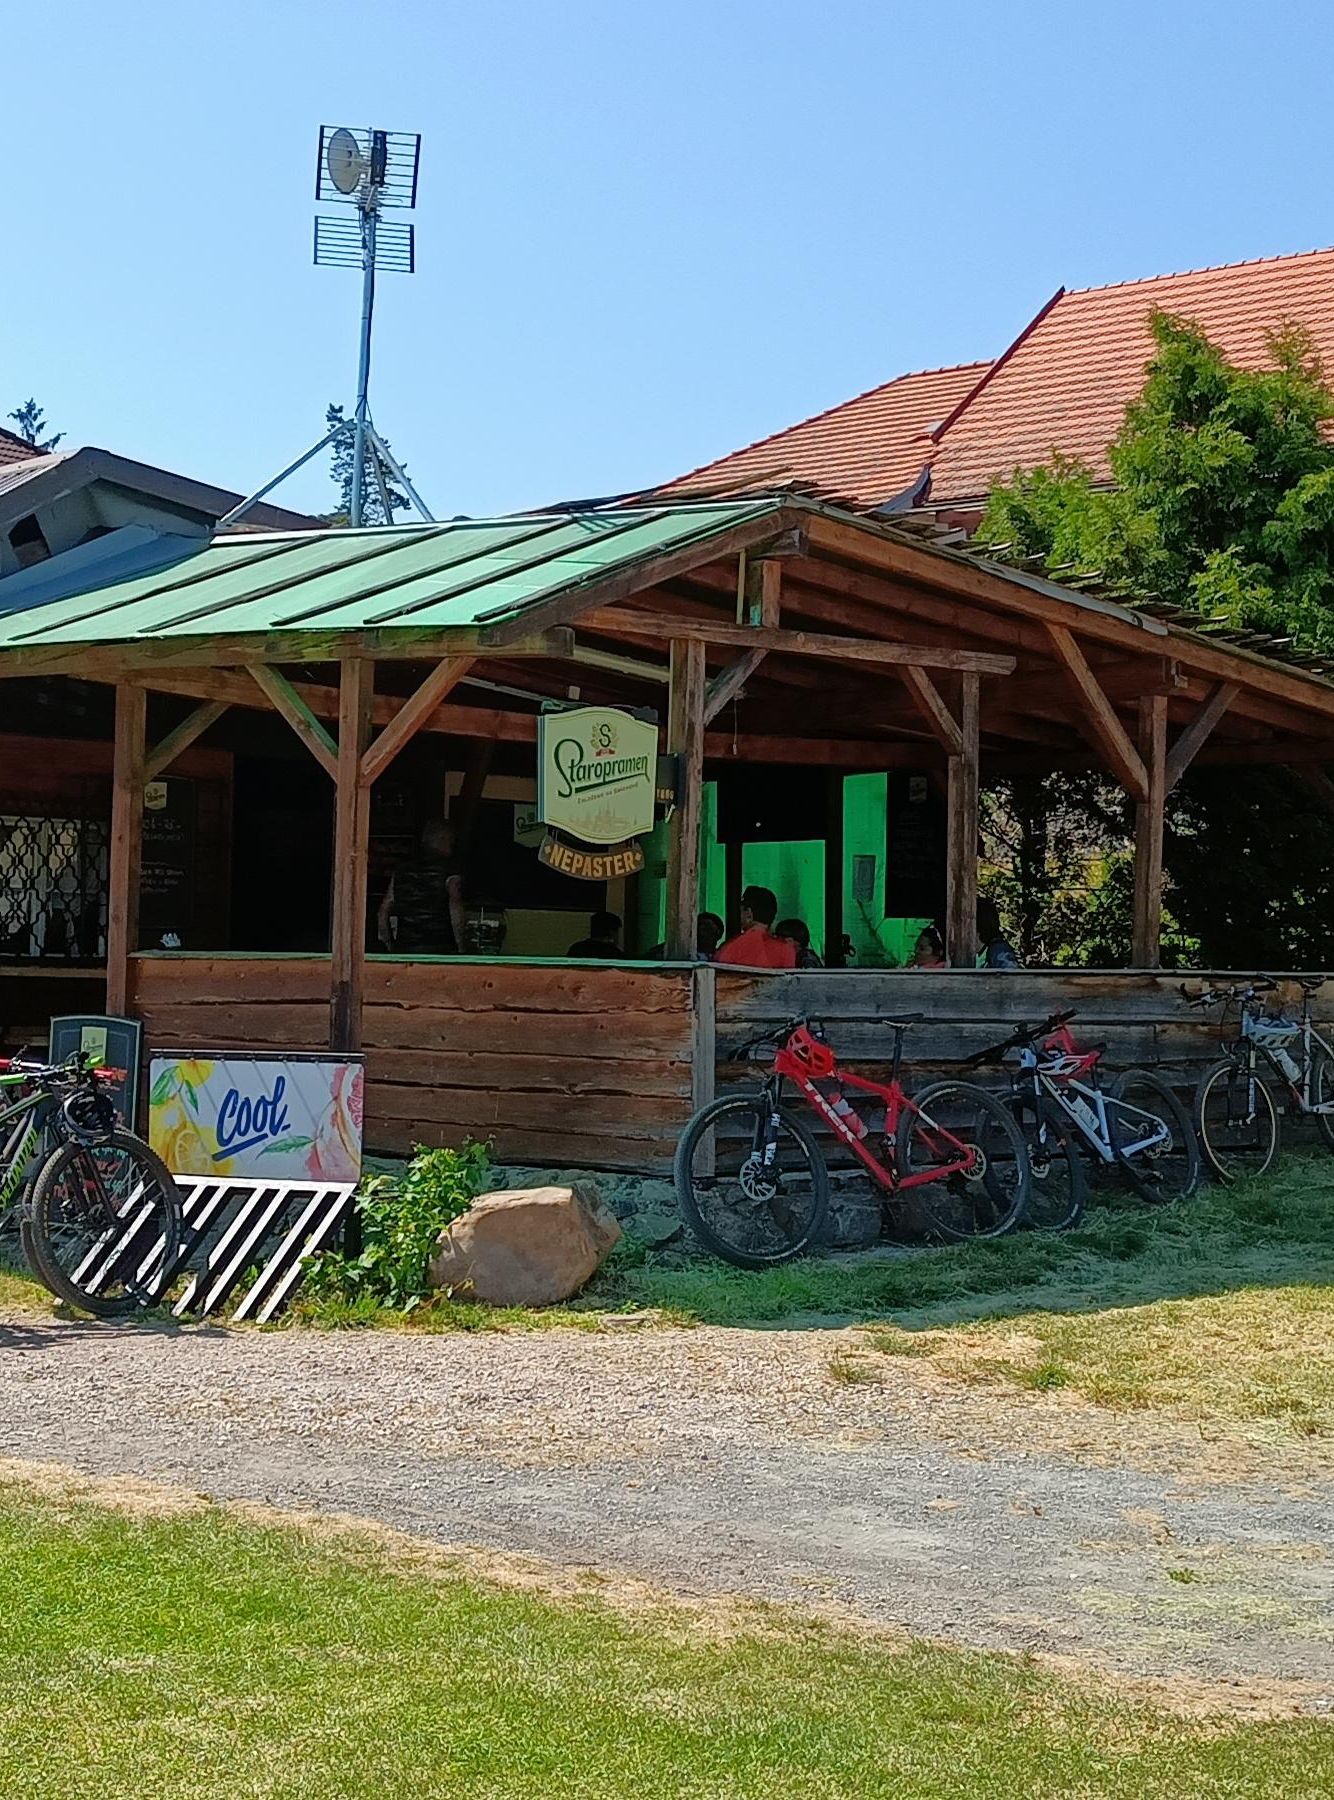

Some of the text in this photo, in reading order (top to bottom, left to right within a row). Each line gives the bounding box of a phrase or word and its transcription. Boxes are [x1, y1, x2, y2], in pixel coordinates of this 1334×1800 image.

[554, 738, 650, 798] Staropramen
[549, 843, 635, 877] NEPASTER
[217, 1075, 288, 1147] Cool
[805, 1078, 857, 1144] TREK
